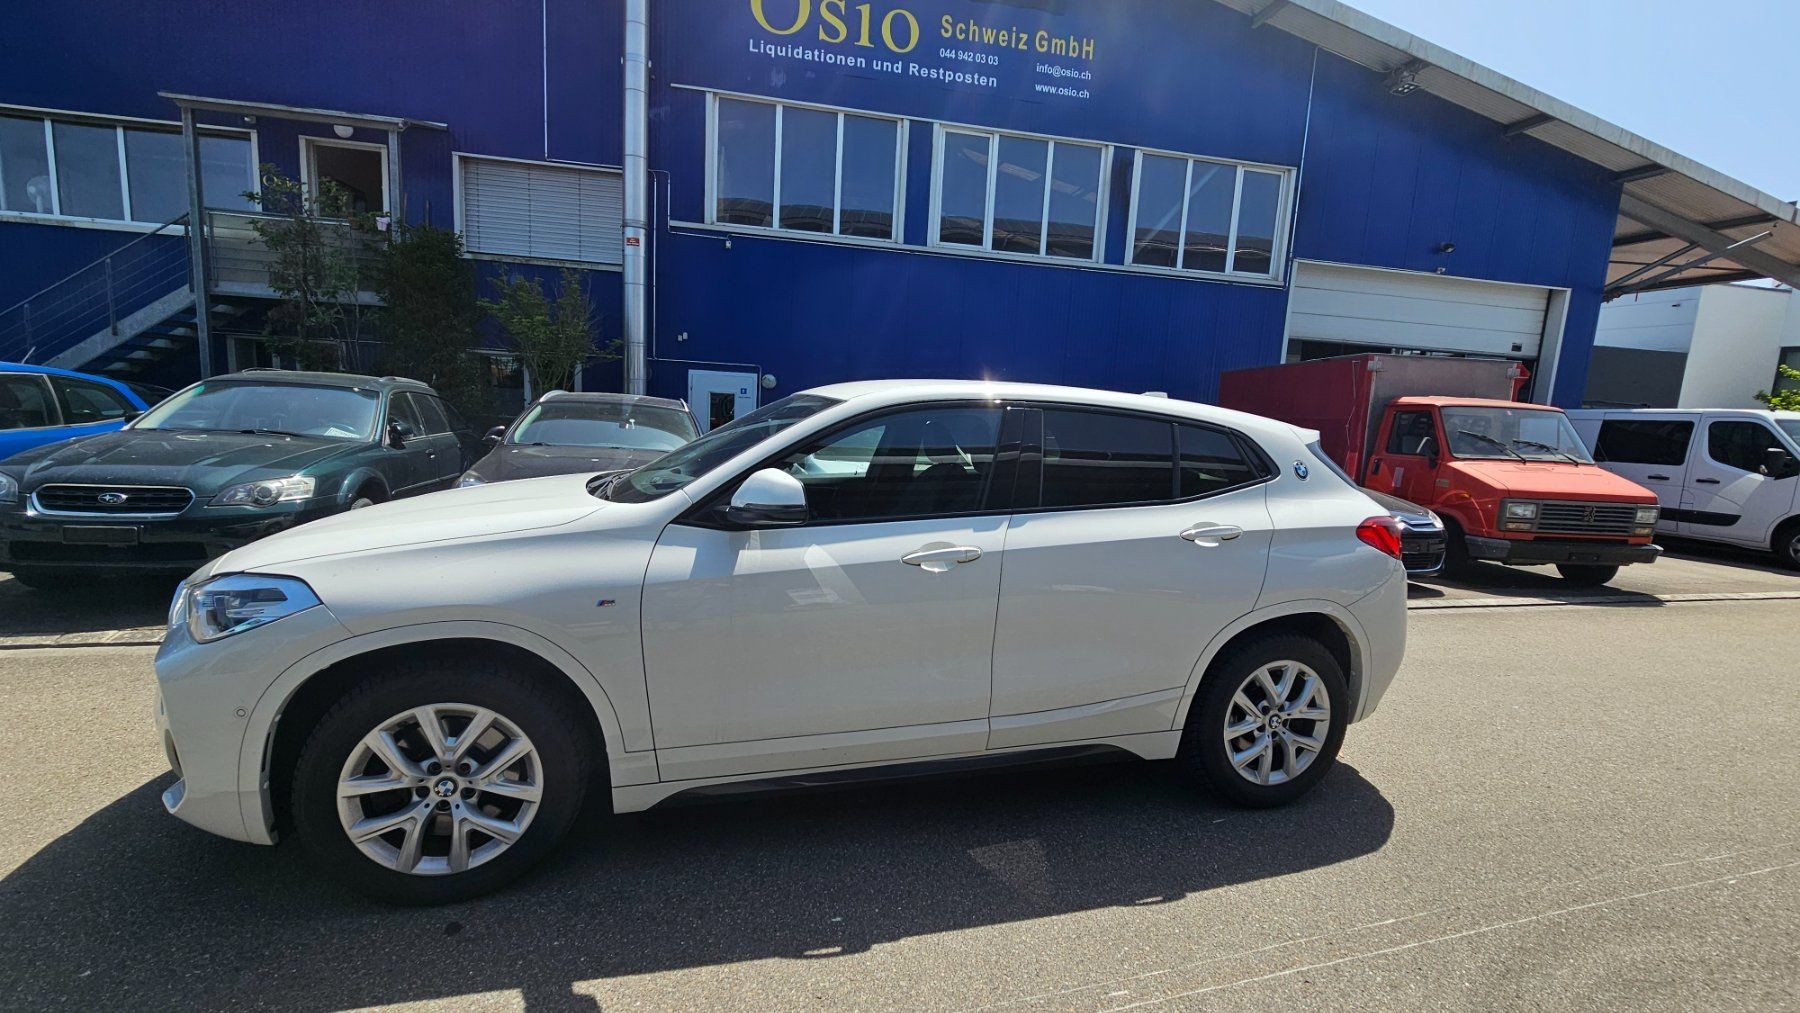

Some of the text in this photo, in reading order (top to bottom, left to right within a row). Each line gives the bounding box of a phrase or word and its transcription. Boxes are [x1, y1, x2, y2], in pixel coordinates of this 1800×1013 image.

[940, 14, 1095, 60] Schweiz GmbH
[749, 39, 998, 88] Liquidationen und Restposten
[939, 48, 999, 65] 044 942 03 03
[1036, 63, 1092, 81] info@osio.ch
[1035, 83, 1090, 99] www.osio.ch
